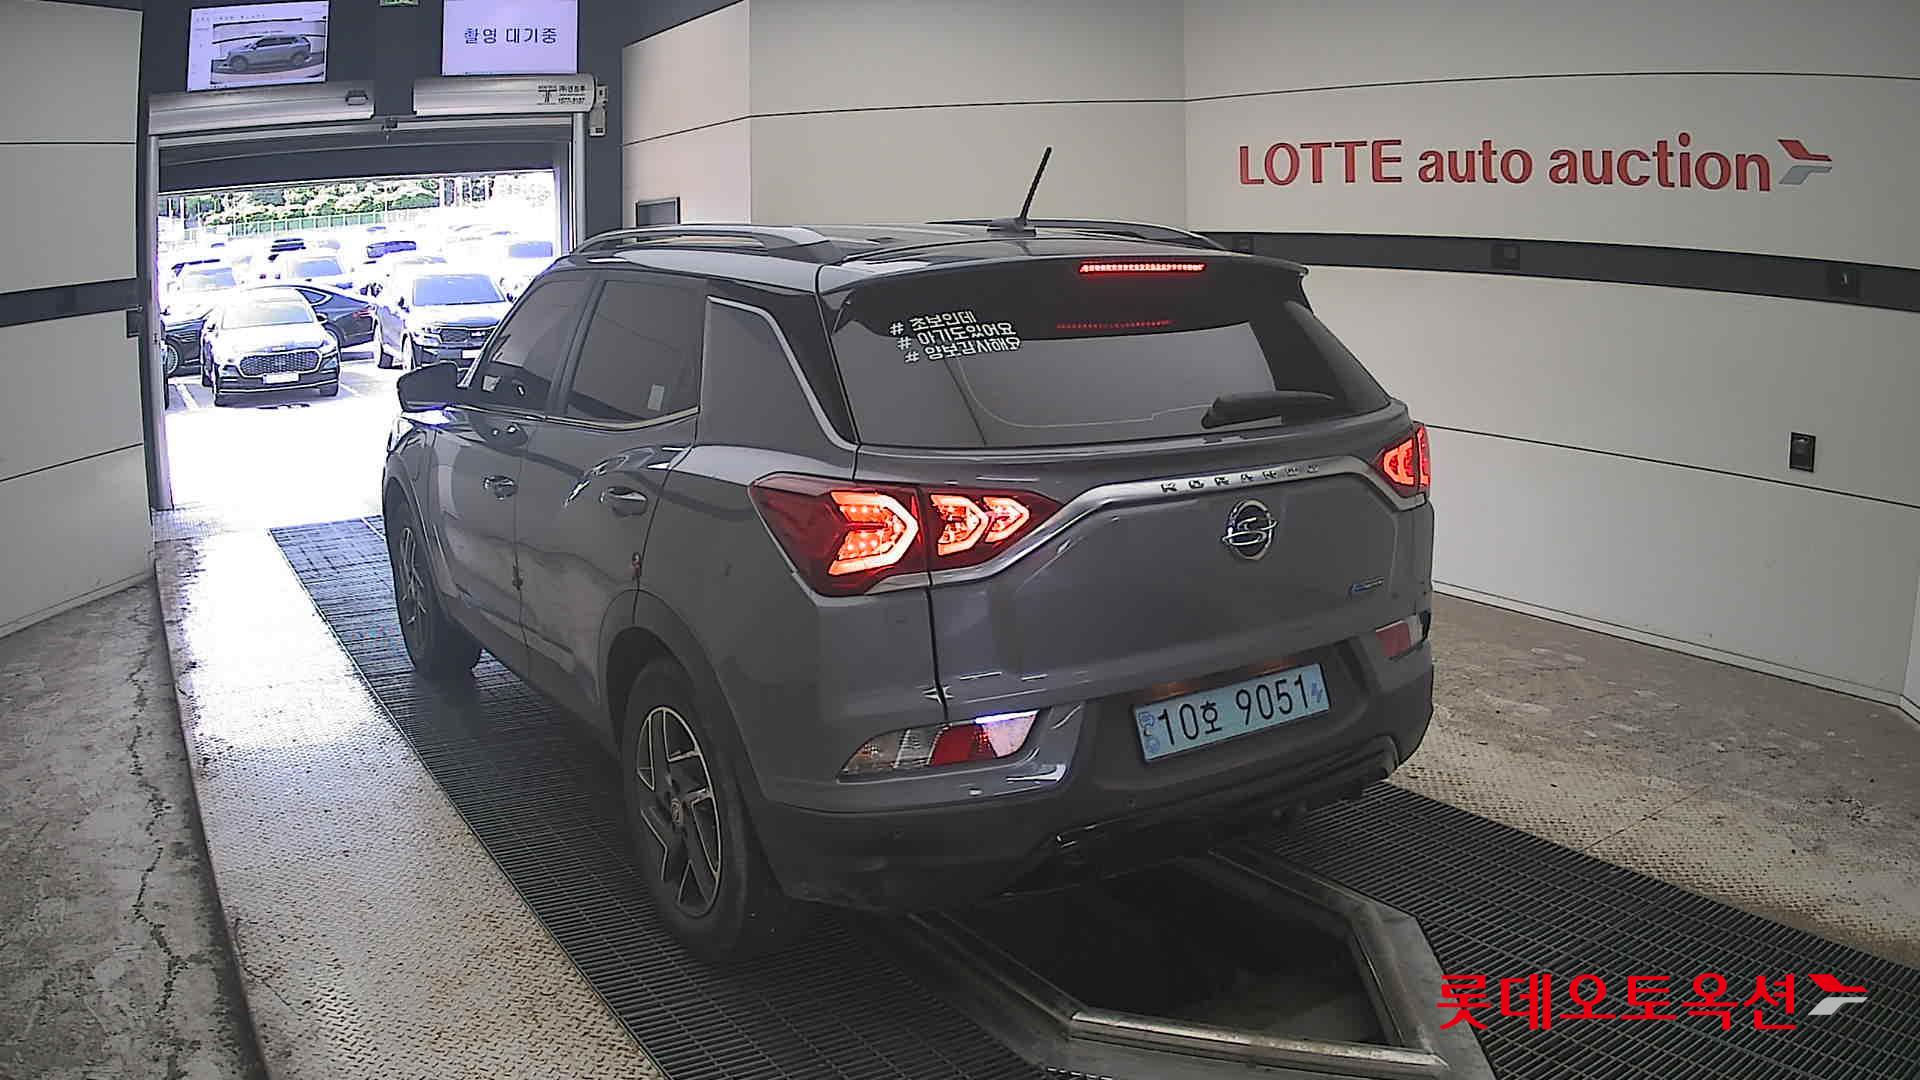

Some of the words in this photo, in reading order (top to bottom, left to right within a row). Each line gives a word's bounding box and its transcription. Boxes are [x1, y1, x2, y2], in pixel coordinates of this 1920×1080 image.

[506, 27, 558, 44] 대기중
[1238, 138, 1402, 186] LOTTE
[1418, 139, 1534, 184] auto
[1548, 131, 1772, 192] auction
[910, 310, 977, 332] 초보인데
[917, 321, 1017, 346] 아기도있어요
[1157, 700, 1222, 746] 10호
[1235, 673, 1309, 726] 9051
